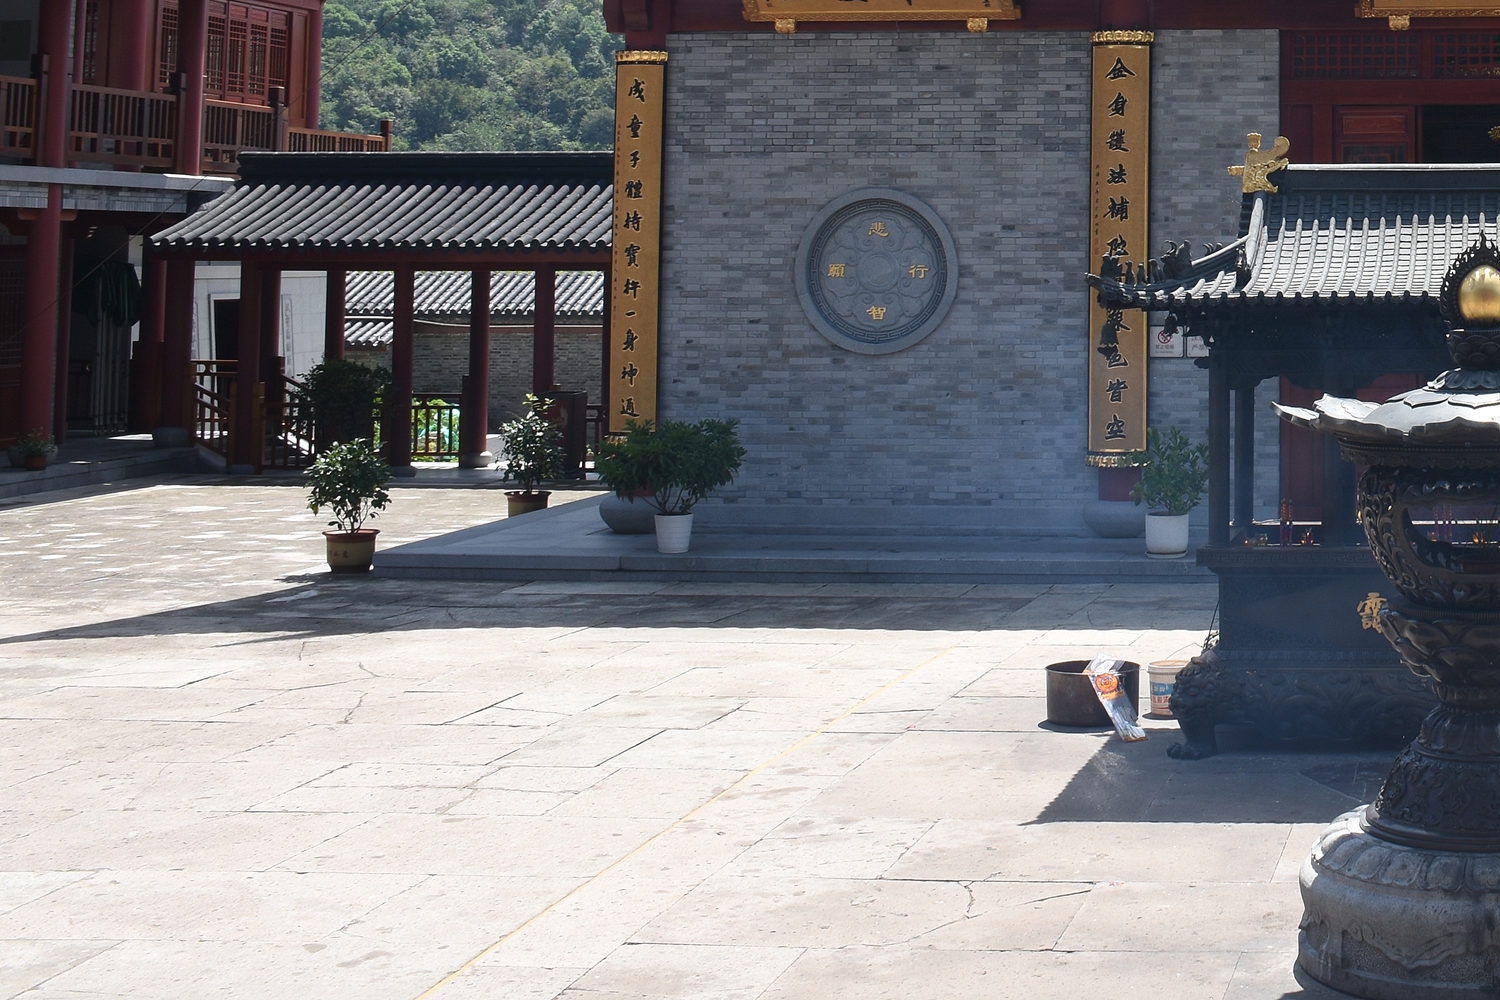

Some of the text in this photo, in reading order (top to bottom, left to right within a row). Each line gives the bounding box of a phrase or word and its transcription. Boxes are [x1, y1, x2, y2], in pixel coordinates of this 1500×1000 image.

[868, 221, 889, 237] 悲
[908, 264, 929, 279] 行
[866, 305, 887, 321] 智
